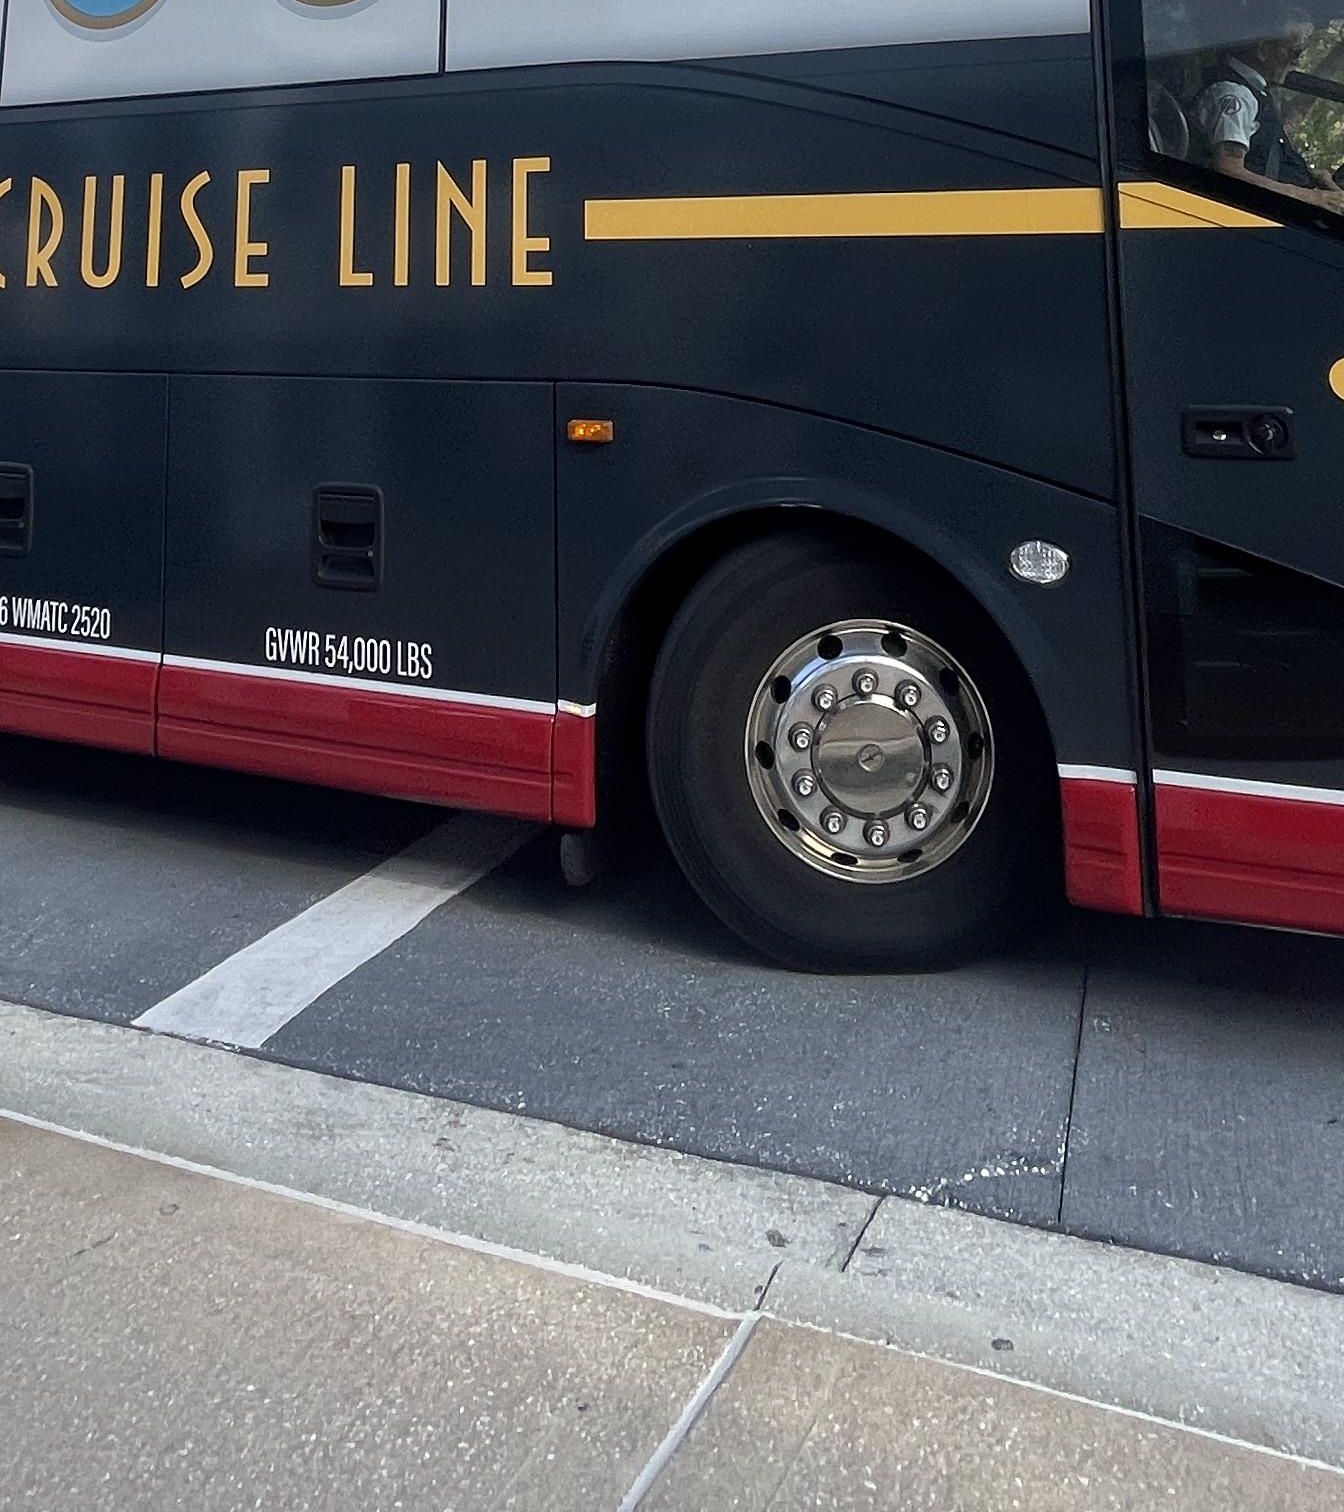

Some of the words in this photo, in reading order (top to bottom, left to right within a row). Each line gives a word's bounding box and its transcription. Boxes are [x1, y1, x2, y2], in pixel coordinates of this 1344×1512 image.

[338, 156, 554, 287] LINE
[12, 596, 69, 633] WMATC
[70, 604, 112, 639] 2520
[265, 626, 320, 665] GVWR
[324, 634, 391, 674] 54,000
[397, 640, 433, 679] LBS
